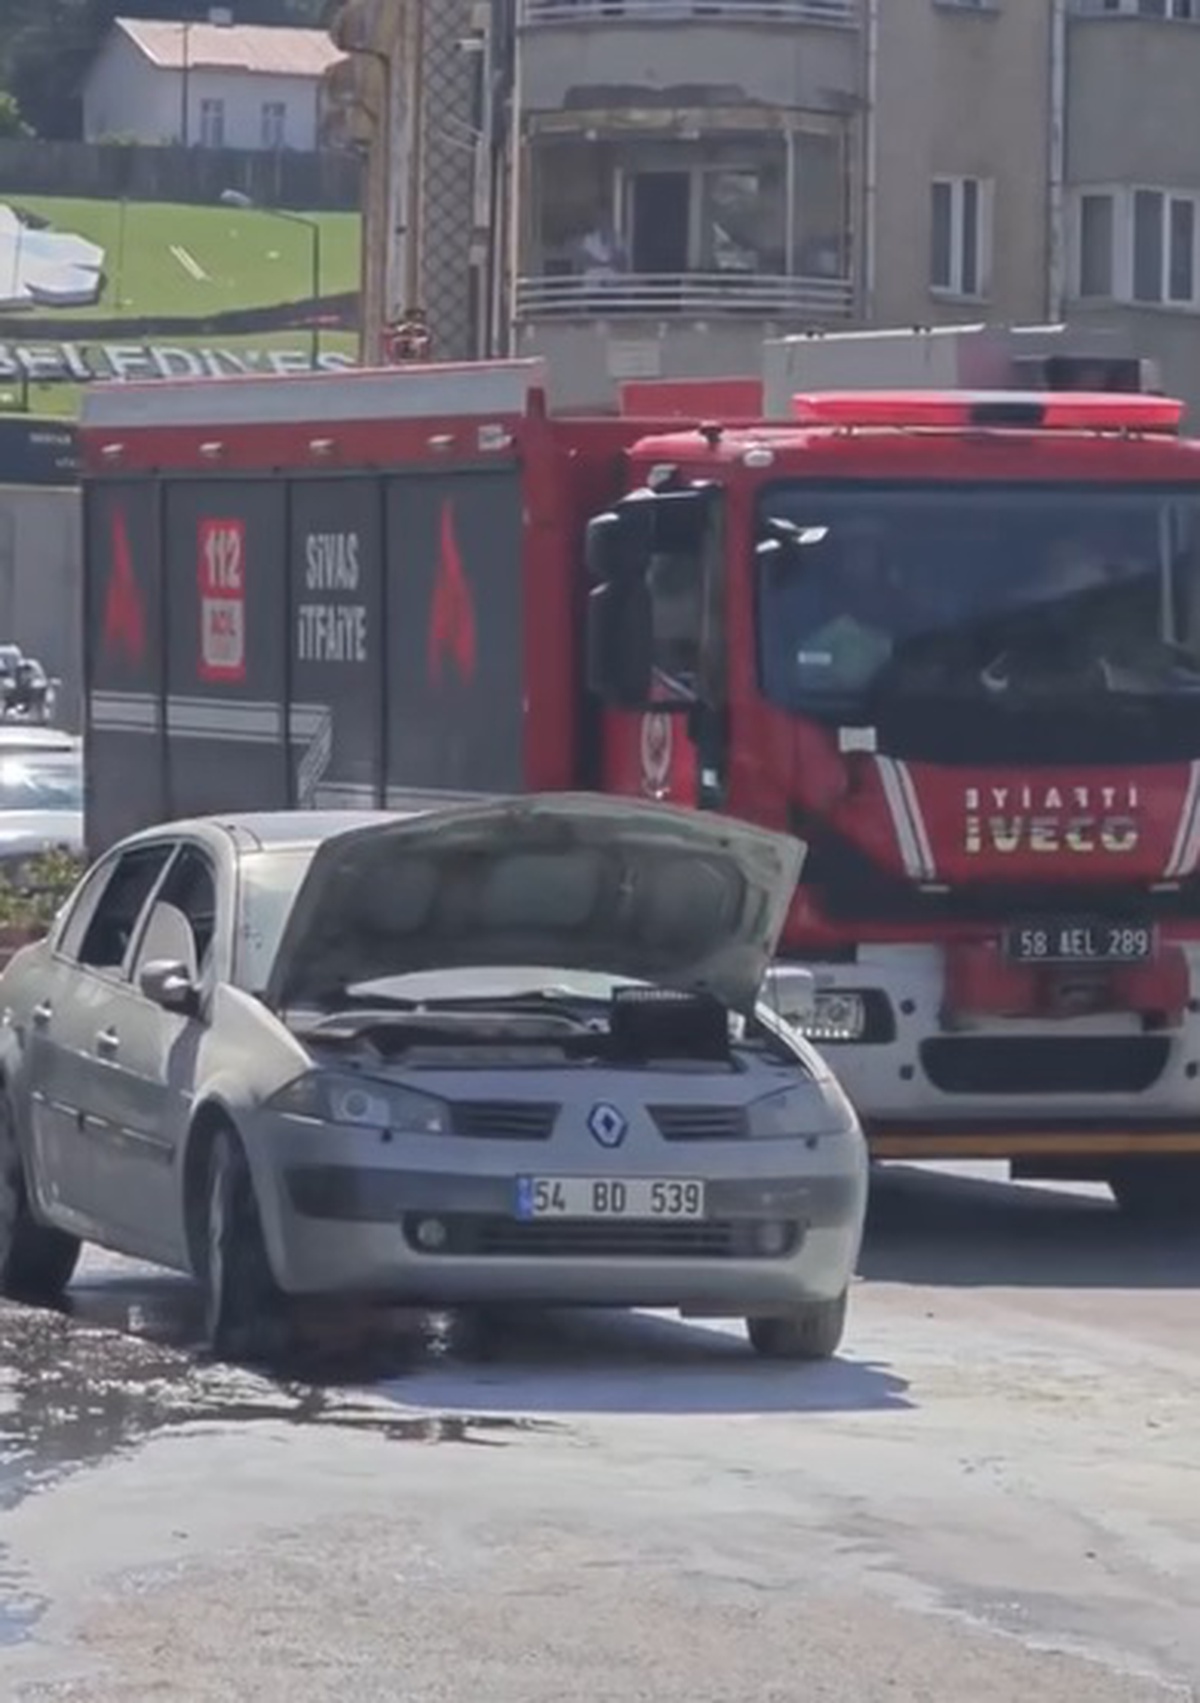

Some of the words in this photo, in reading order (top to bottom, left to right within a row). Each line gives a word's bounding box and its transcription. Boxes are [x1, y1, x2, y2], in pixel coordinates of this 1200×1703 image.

[205, 528, 241, 589] 112
[306, 532, 359, 590] SİVAS
[965, 815, 1139, 852] IVECO
[1020, 930, 1049, 956] 58
[1059, 929, 1095, 956] AEL
[1108, 929, 1149, 956] 289
[534, 1180, 566, 1212] 54
[592, 1181, 627, 1213] BD
[650, 1182, 700, 1214] 539
